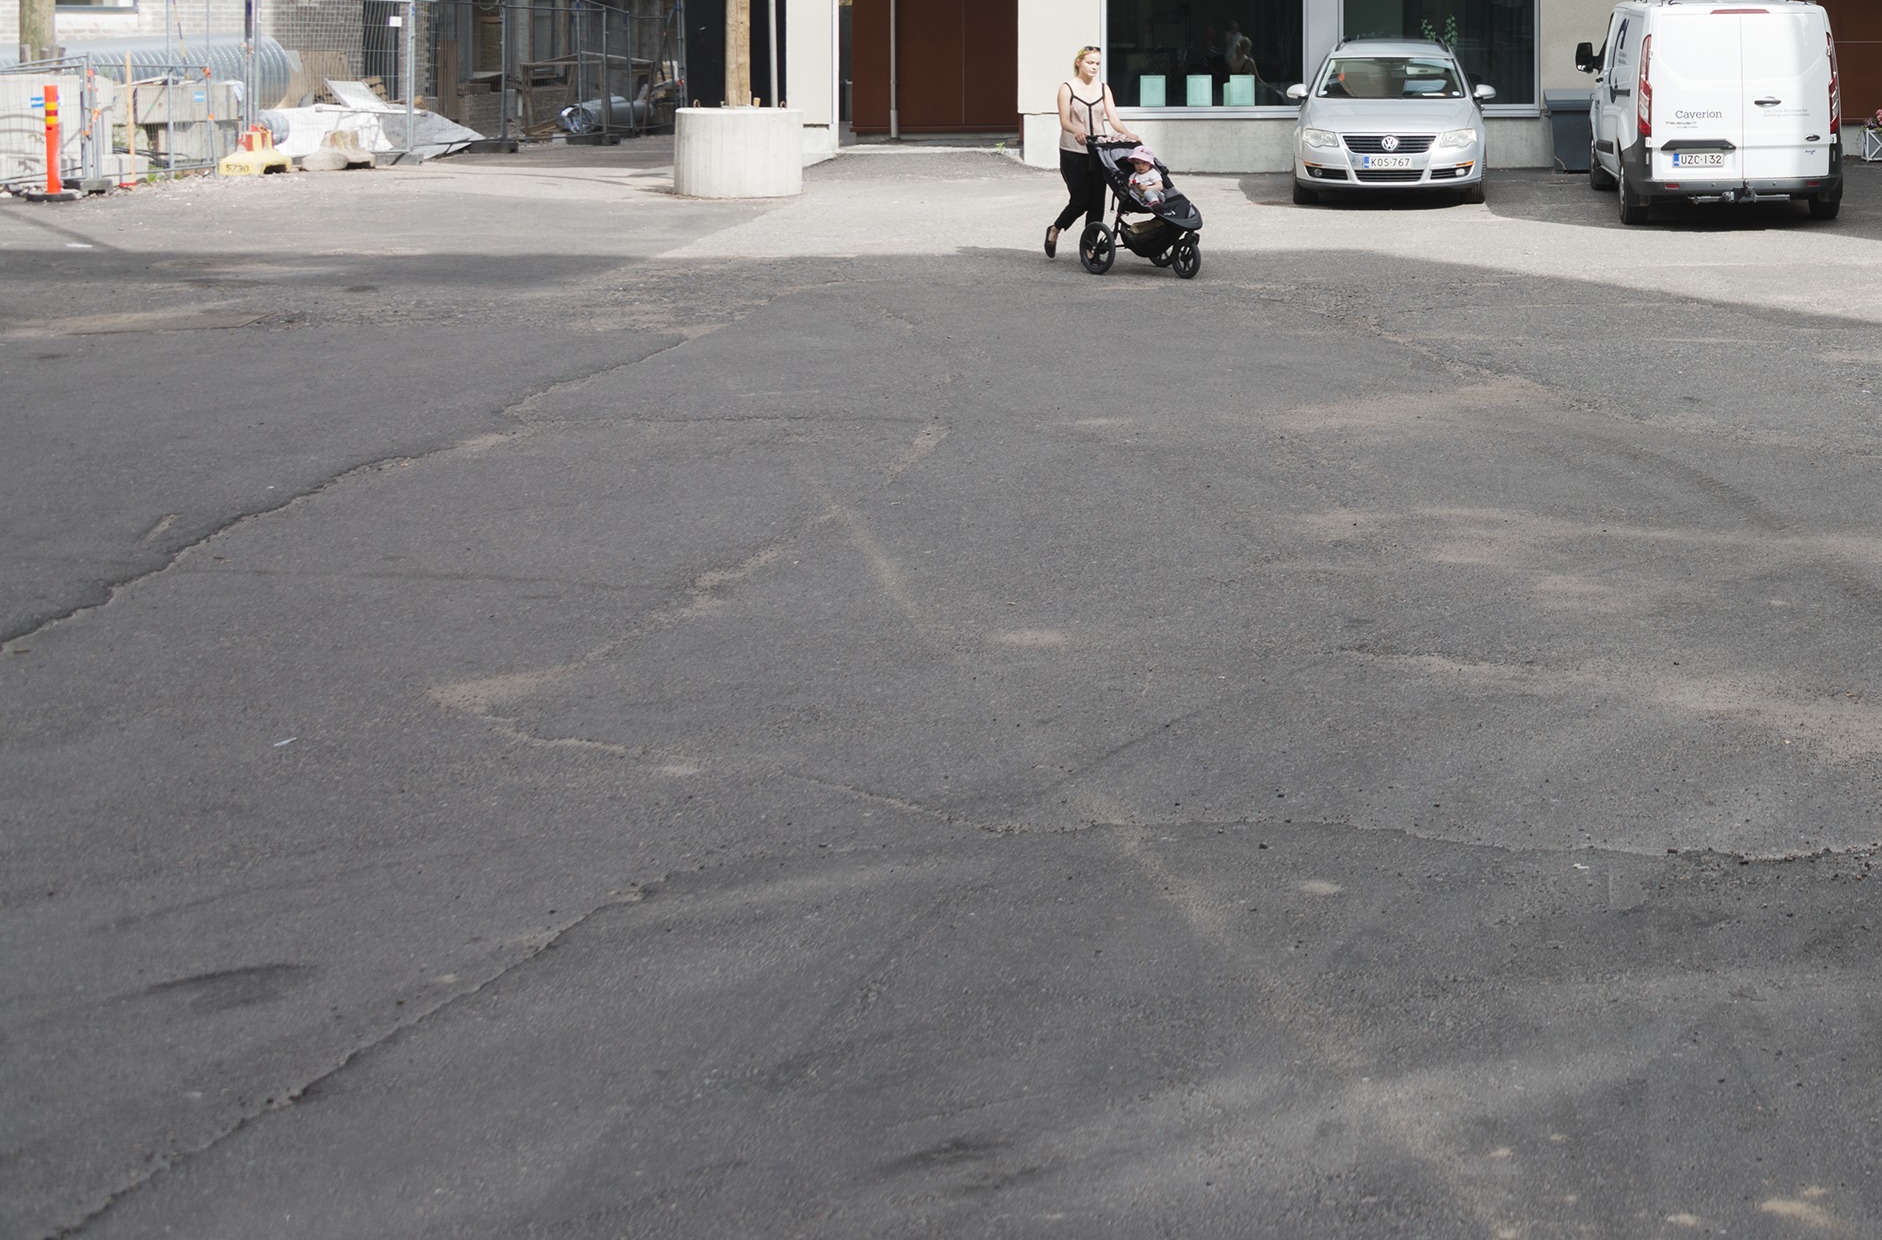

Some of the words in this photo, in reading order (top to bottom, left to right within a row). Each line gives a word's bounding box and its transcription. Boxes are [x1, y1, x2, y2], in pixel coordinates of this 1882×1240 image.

[1675, 110, 1722, 119] Caverion
[1371, 158, 1410, 167] KOS-767
[1681, 155, 1722, 165] UZC-132
